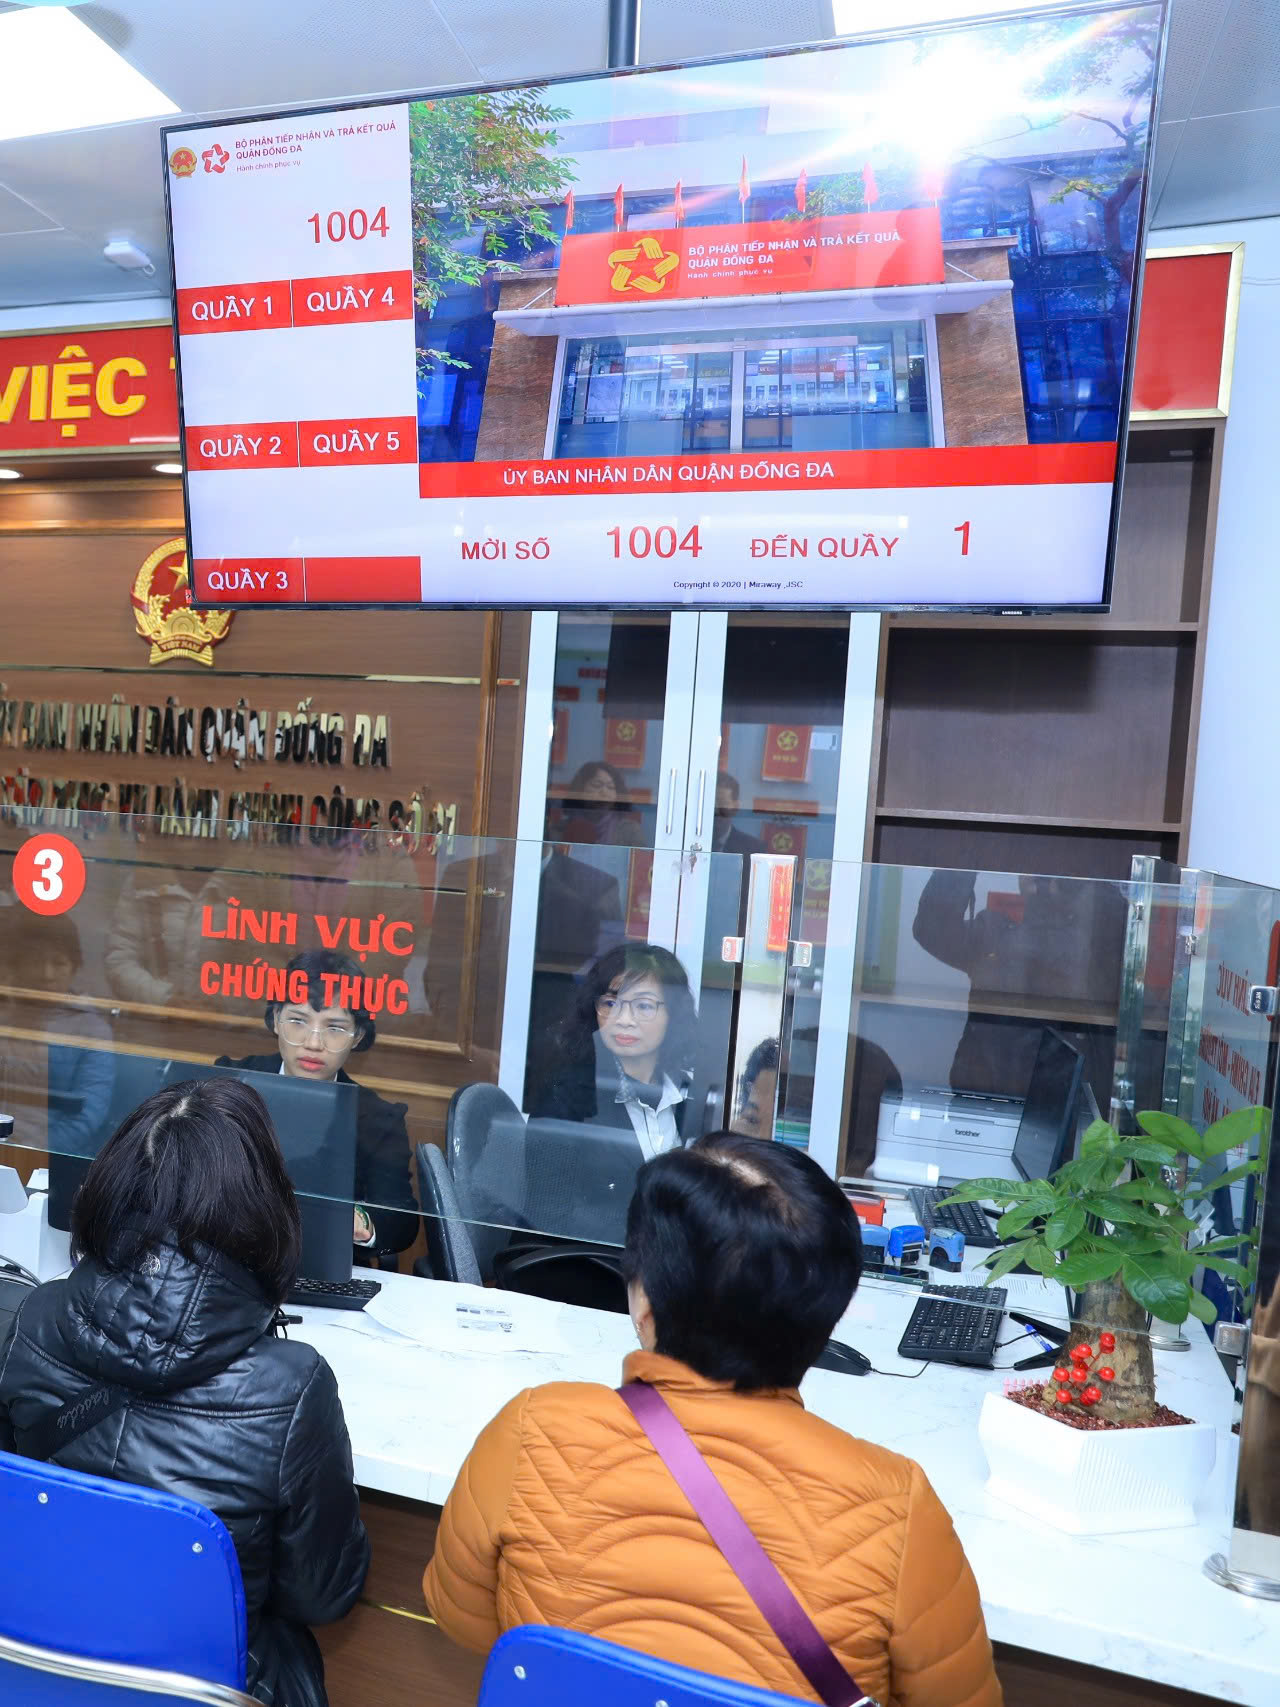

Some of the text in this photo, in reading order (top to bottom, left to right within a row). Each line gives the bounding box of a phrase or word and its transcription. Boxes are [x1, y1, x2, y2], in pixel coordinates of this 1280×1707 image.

[236, 140, 247, 149] BỘ
[276, 133, 293, 144] TIẾP
[296, 131, 321, 141] NHẬN
[323, 129, 335, 138] VÀ
[337, 126, 354, 136] TRẢ
[357, 123, 374, 134] KẾT
[376, 120, 396, 132] QUẢ
[236, 149, 261, 160] QUẬN
[290, 144, 302, 153] ĐA
[236, 163, 254, 172] Hành
[255, 160, 273, 170] chính
[307, 206, 389, 244] 1004
[688, 246, 704, 256] BỘ
[742, 240, 765, 252] TIẾP
[768, 239, 799, 251] NHẬN
[803, 235, 817, 247] VÀ
[820, 233, 843, 246] TRẢ
[846, 231, 870, 244] KẾT
[874, 229, 901, 242] QUẢ
[688, 257, 718, 270] QUẬN
[758, 254, 774, 264] ĐA
[191, 295, 273, 321] QUẦY 1
[306, 286, 394, 312] QUẦY 4
[199, 433, 282, 459] QUẦY 2
[313, 428, 400, 455] QUẦY 5
[503, 466, 528, 486] ỦY
[532, 468, 569, 485] BAN
[575, 463, 628, 484] NHÂN
[632, 461, 673, 482] DÂN
[678, 461, 734, 485] QUẬN
[805, 460, 835, 478] ĐA
[461, 521, 972, 561] MỜI SỐ 1004 ĐẾN QUẦY 1
[207, 569, 289, 592] QUẦY 3
[673, 581, 711, 589] Copyright
[748, 581, 782, 589] Miraway
[74, 693, 140, 753] NHÂN
[144, 696, 196, 757] DÂN
[200, 697, 267, 768] QUẬN
[352, 713, 388, 767] ĐA
[32, 848, 63, 901] 3
[201, 896, 414, 962] LĨNH VỰC
[200, 957, 409, 1020] CHỨNG THỰC
[955, 1129, 980, 1137] brother
